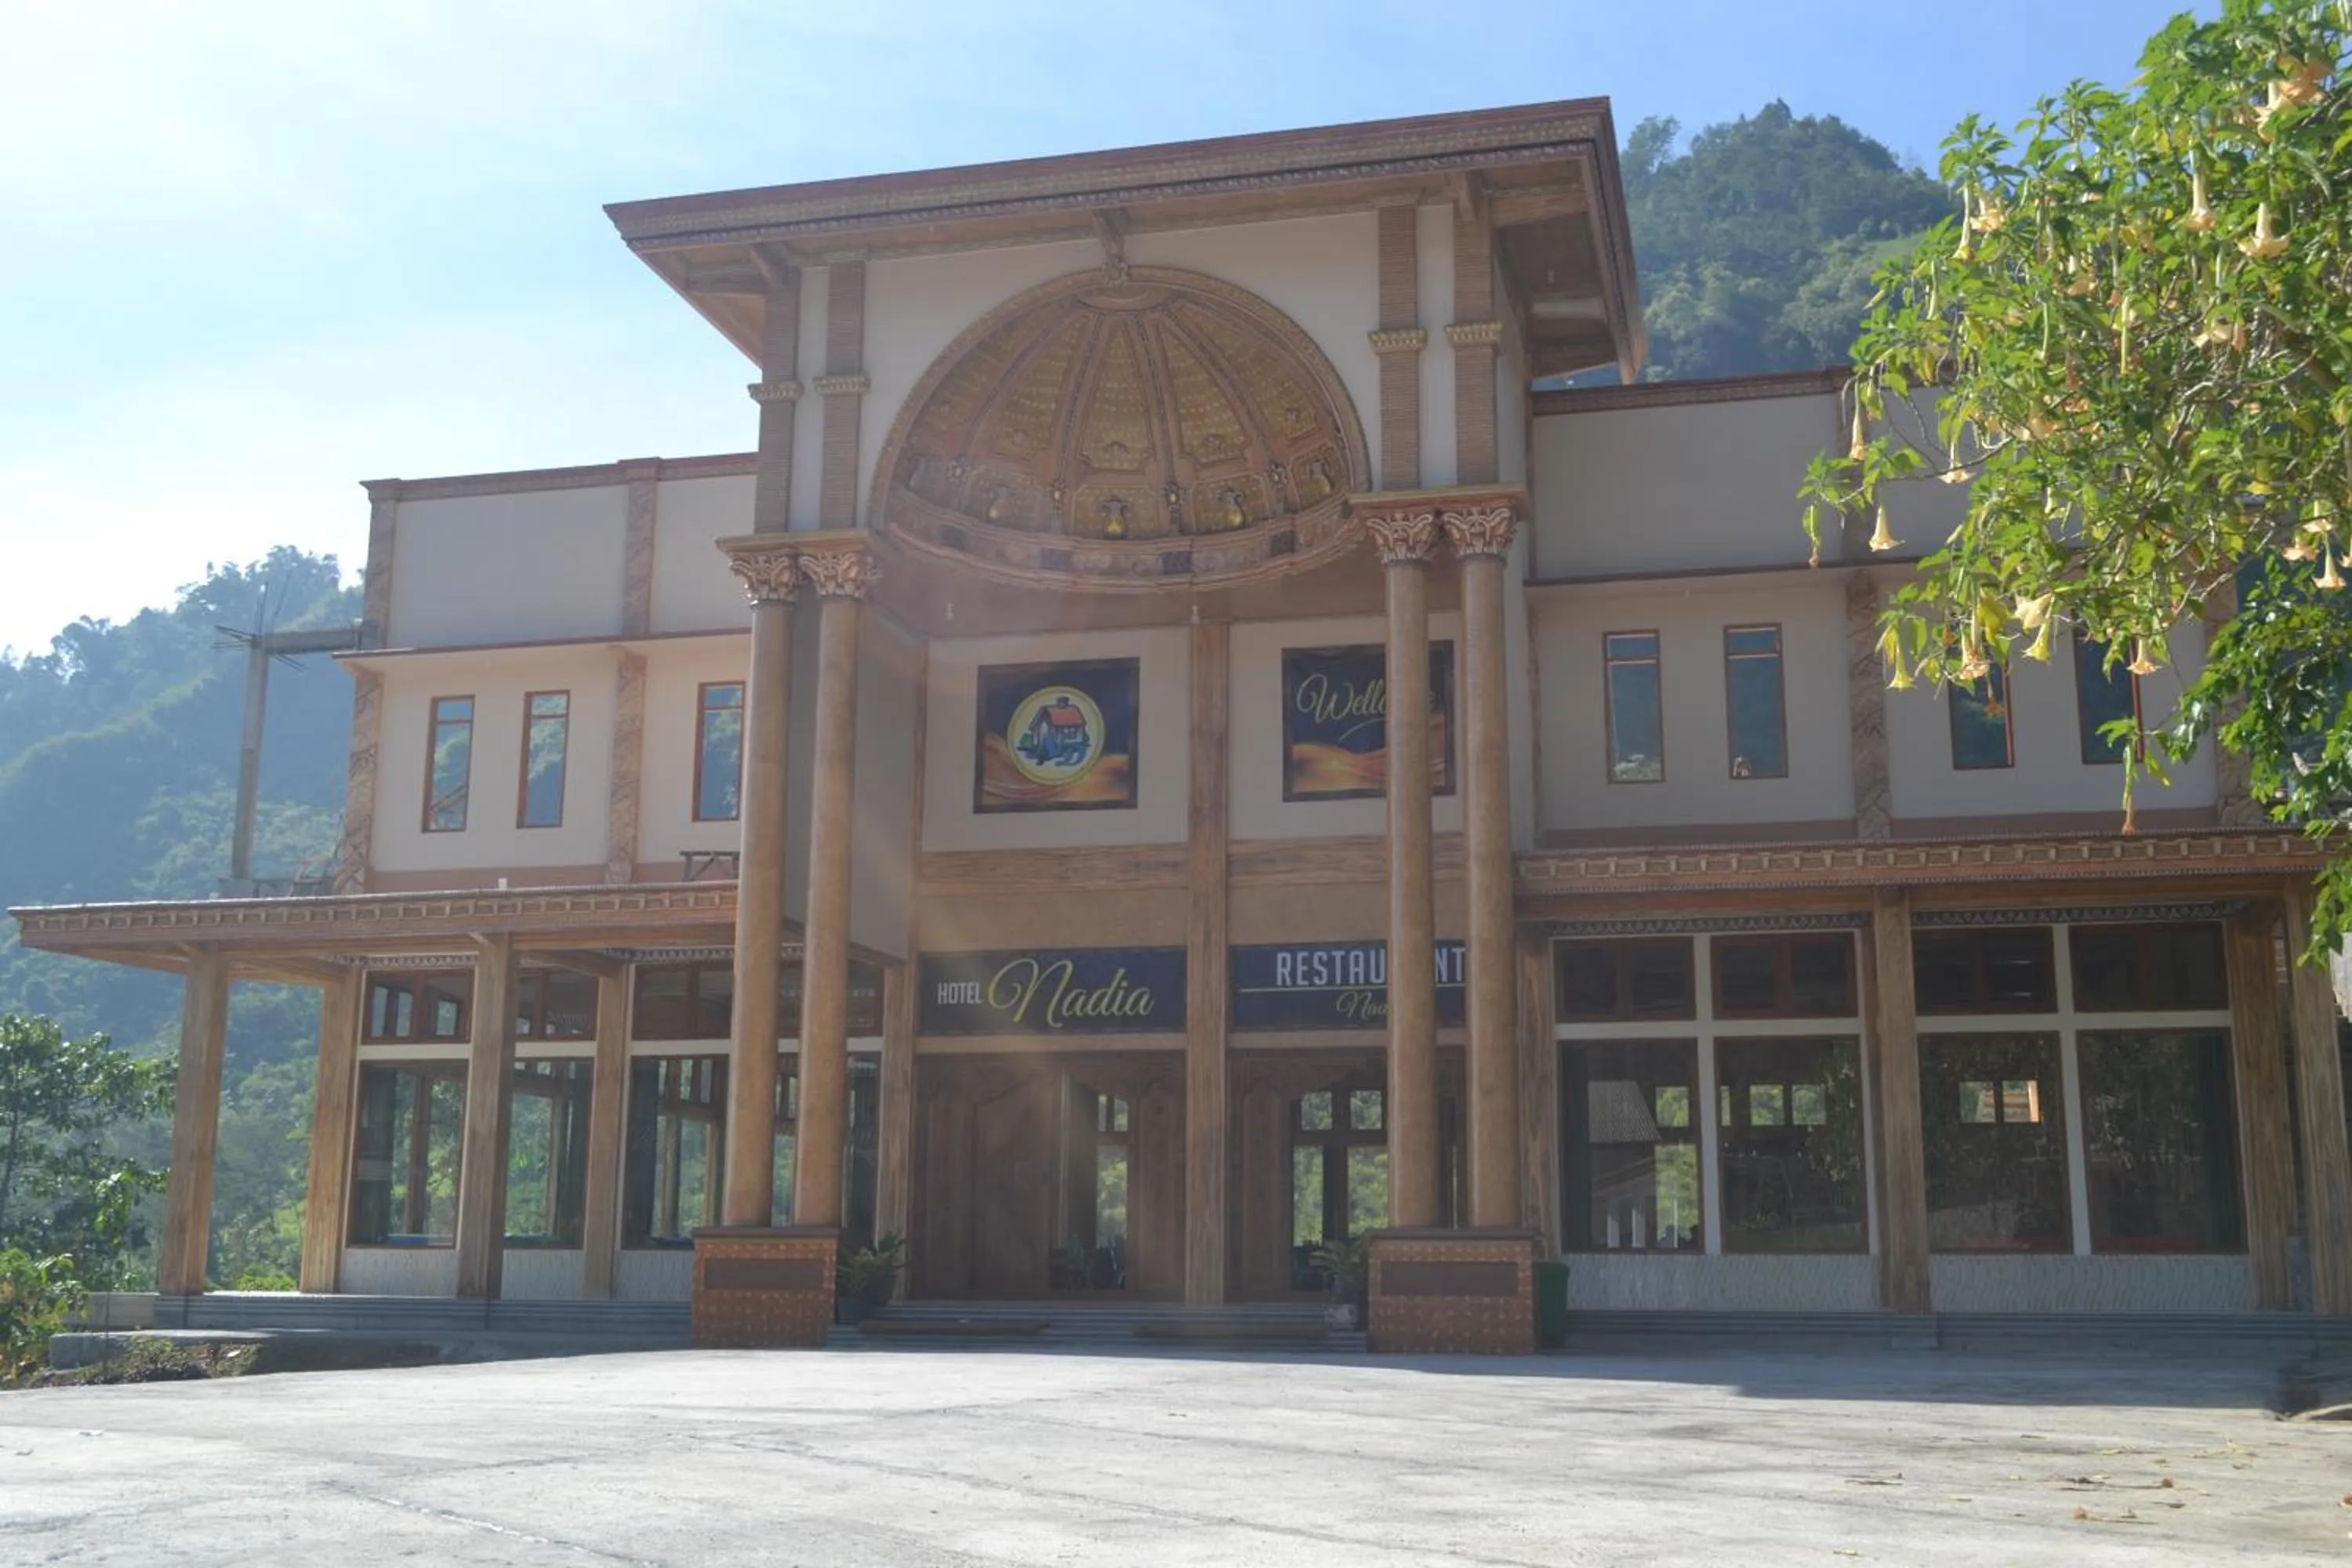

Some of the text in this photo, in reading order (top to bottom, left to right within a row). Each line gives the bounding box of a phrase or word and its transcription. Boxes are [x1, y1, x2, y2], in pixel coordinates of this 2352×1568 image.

[937, 957, 1155, 1028] HOTEL Nadia
[1276, 947, 1466, 986] RESTAUNT
